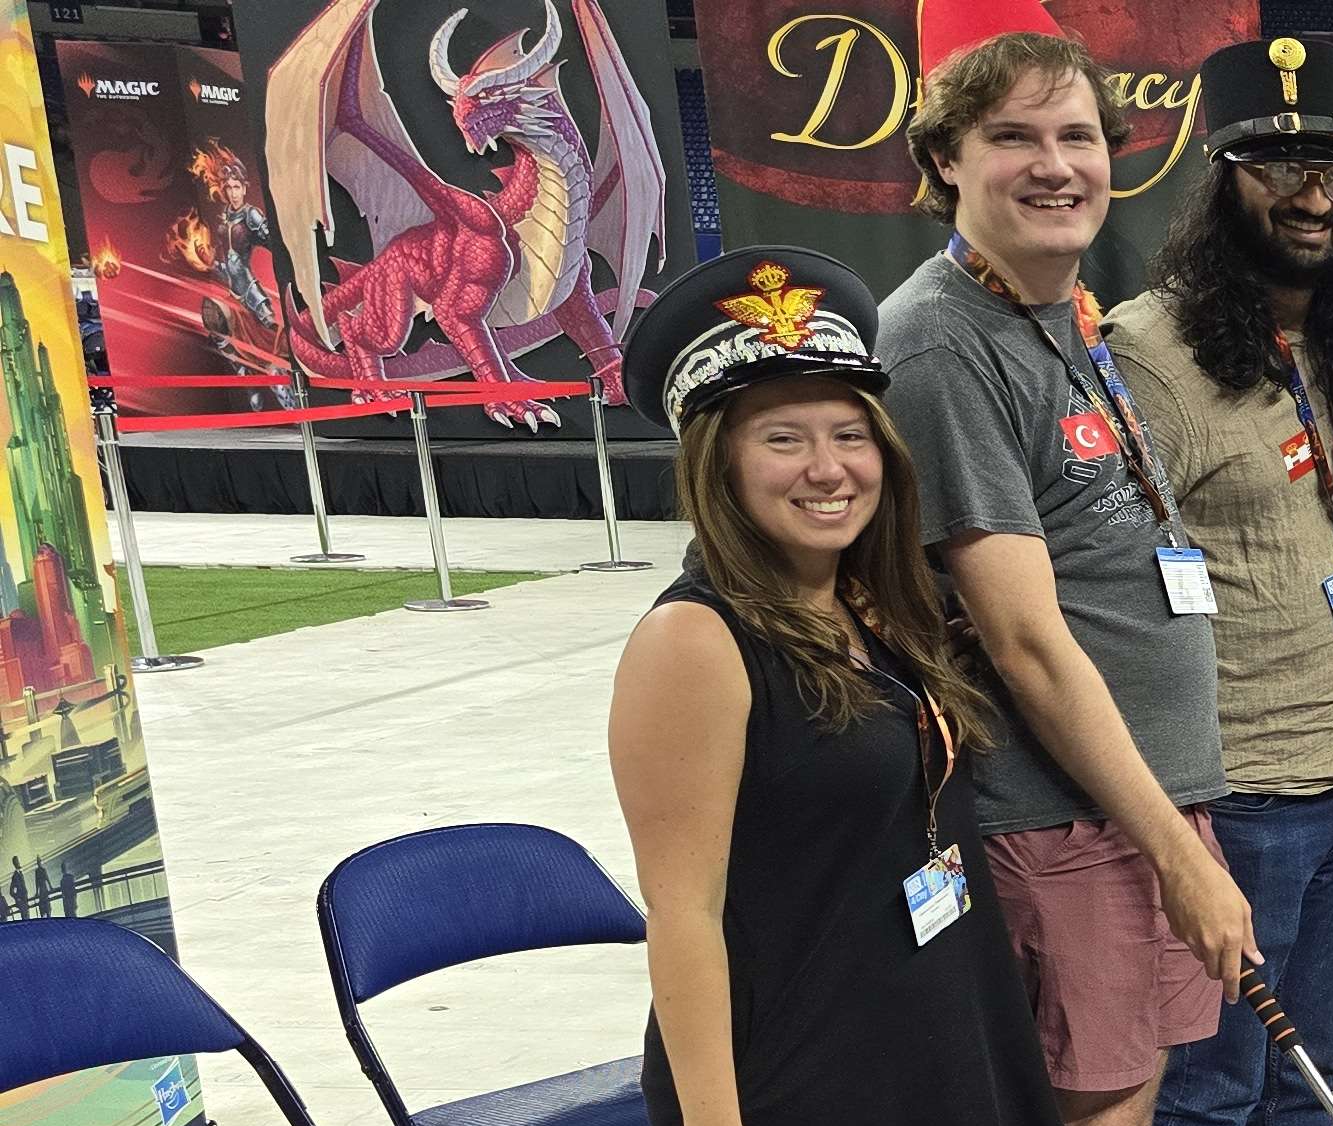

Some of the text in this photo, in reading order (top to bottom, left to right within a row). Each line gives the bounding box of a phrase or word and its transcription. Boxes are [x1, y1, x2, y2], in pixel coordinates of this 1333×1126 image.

[54, 7, 80, 20] 121
[96, 80, 160, 96] MAGIC
[201, 85, 240, 102] MAGIC
